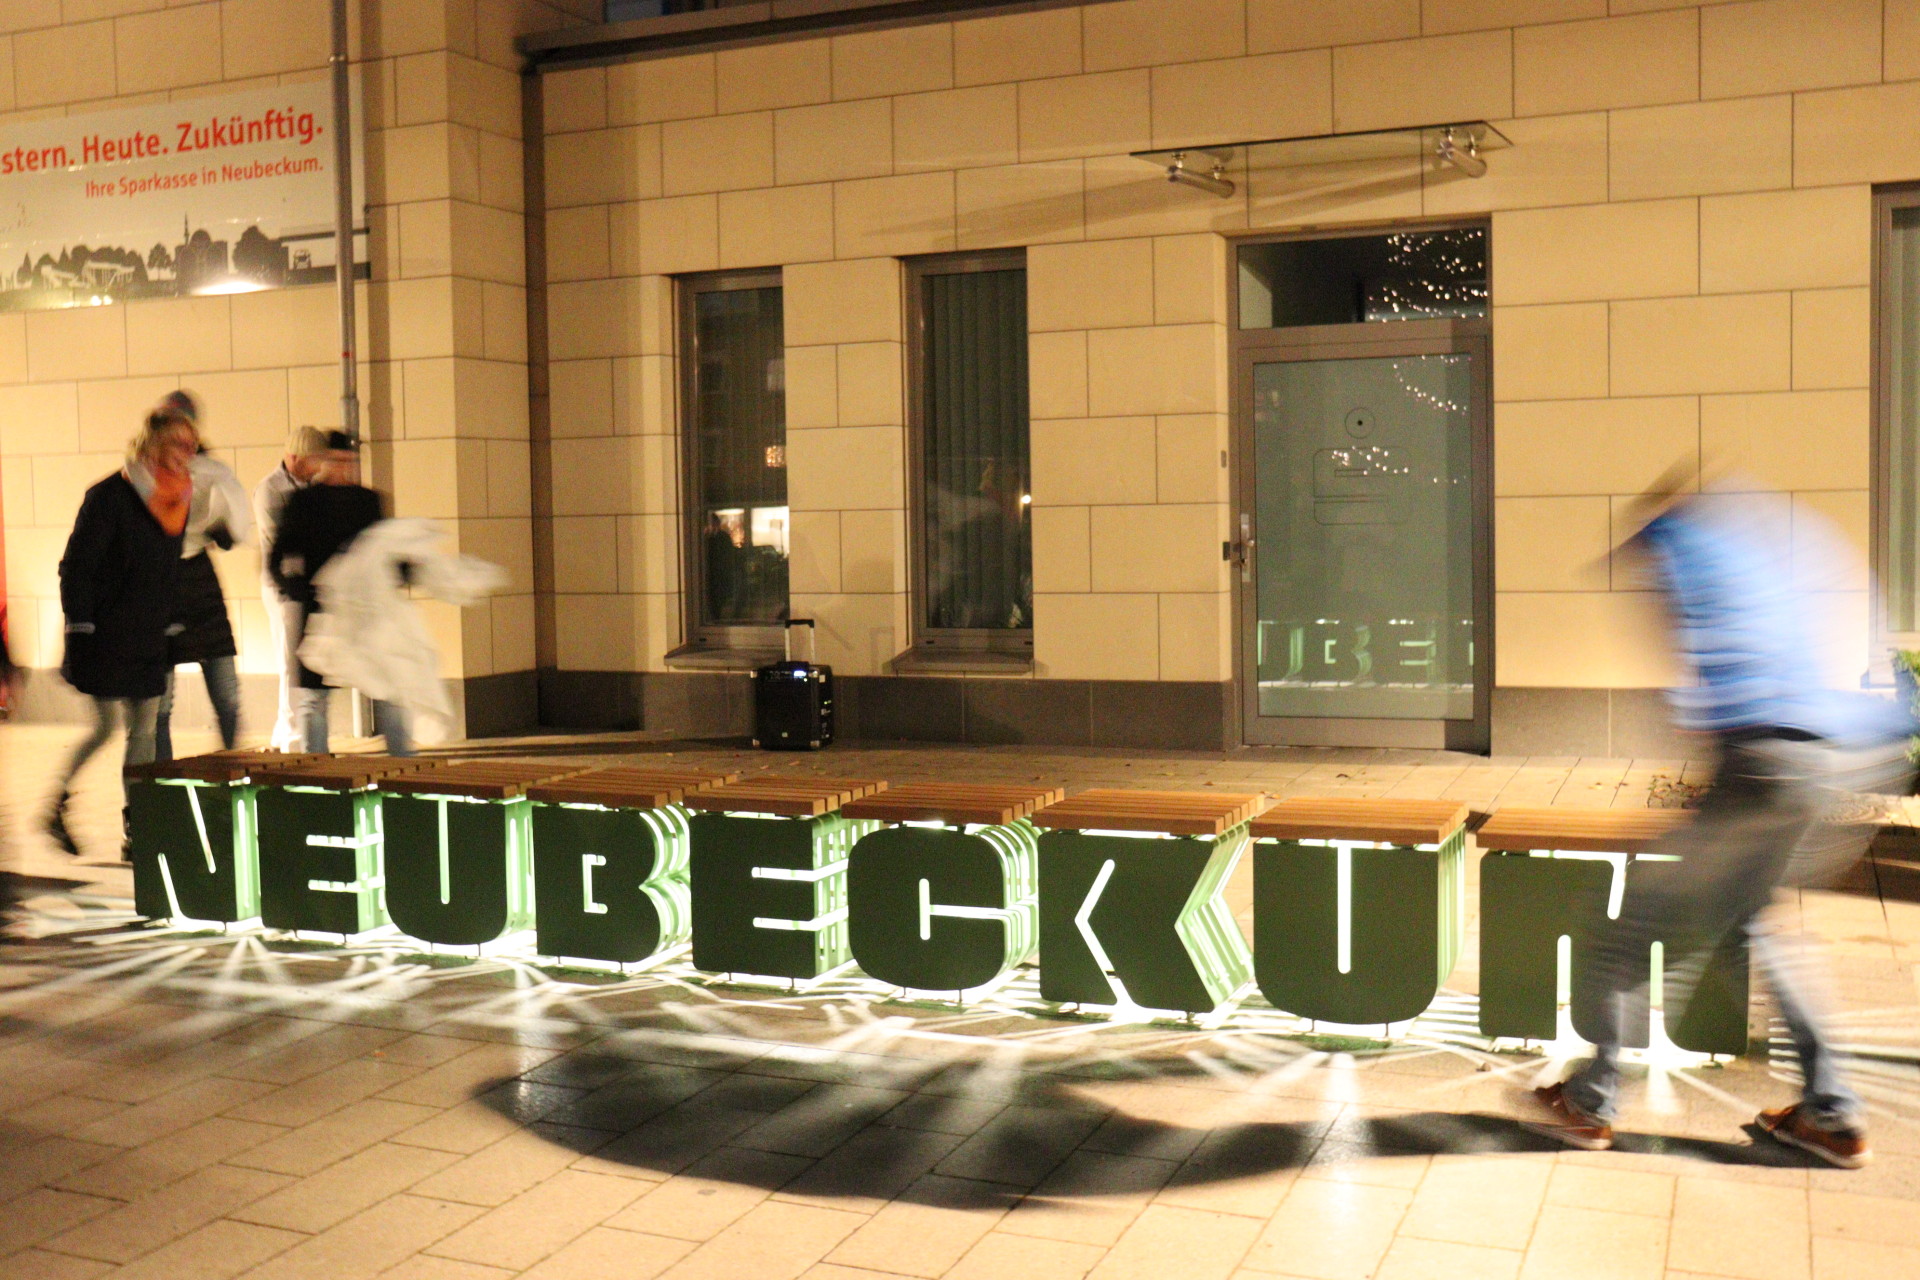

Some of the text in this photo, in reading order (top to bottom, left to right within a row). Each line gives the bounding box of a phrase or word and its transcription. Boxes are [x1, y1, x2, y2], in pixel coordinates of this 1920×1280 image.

[2, 106, 324, 174] stern. Heute. Zukünftig.
[86, 155, 324, 198] Ihre Sparkasse in Neubeckum.
[130, 782, 1750, 1055] NEUBECKUM
